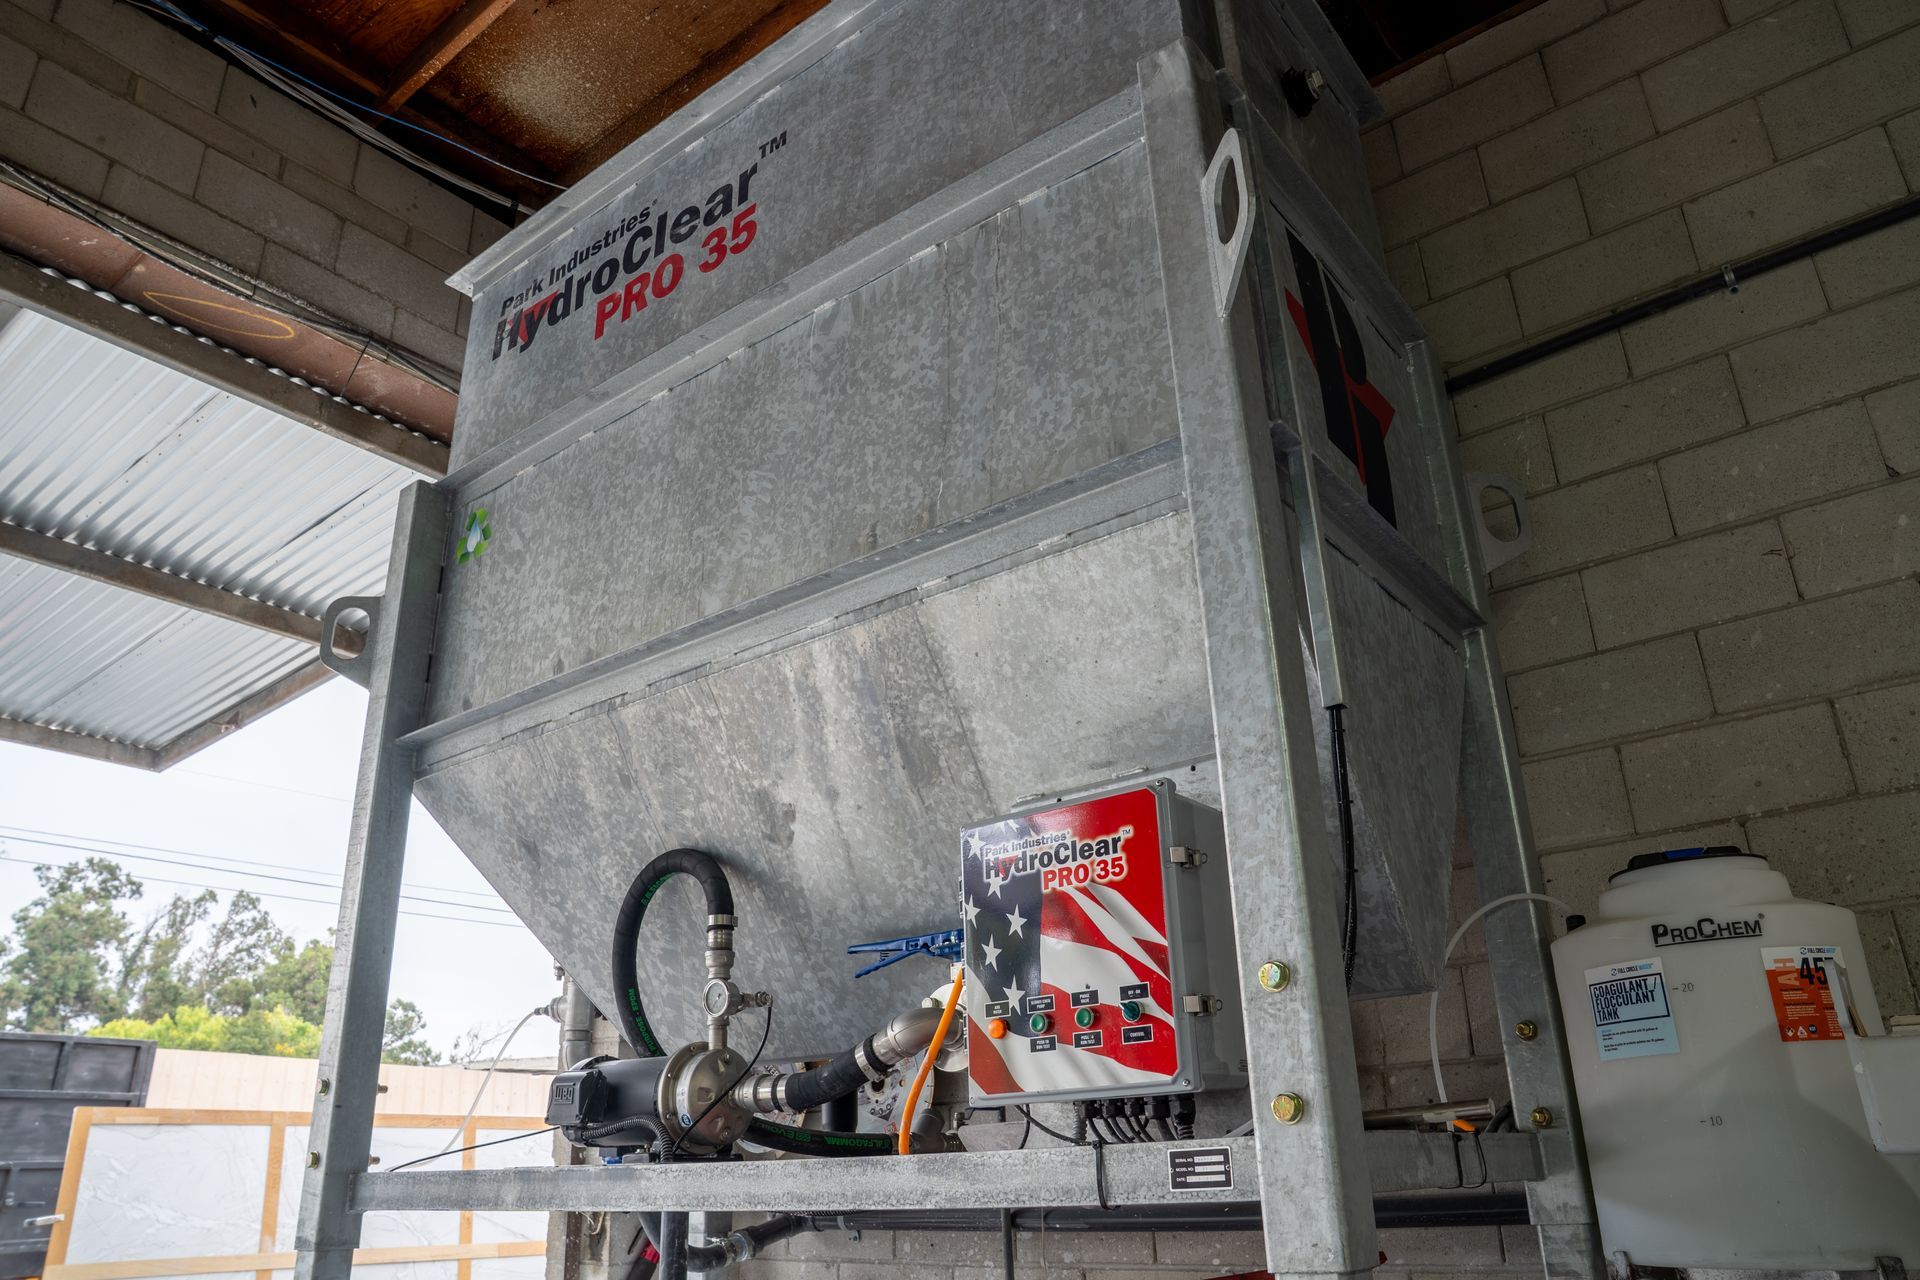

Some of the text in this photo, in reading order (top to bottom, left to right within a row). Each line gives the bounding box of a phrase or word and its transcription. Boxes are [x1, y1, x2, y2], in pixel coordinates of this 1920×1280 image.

[492, 162, 759, 361] HydroClear
[594, 203, 758, 341] PRO 35
[500, 275, 544, 317] Park
[985, 843, 1009, 857] Park
[985, 835, 1122, 882] HydroClear
[1043, 856, 1125, 891] PRO 35
[1800, 957, 1834, 986] 45
[1593, 978, 1648, 999] COAGULANT
[1595, 989, 1656, 1011] FLOCCULANT
[1597, 1007, 1620, 1023] TANK
